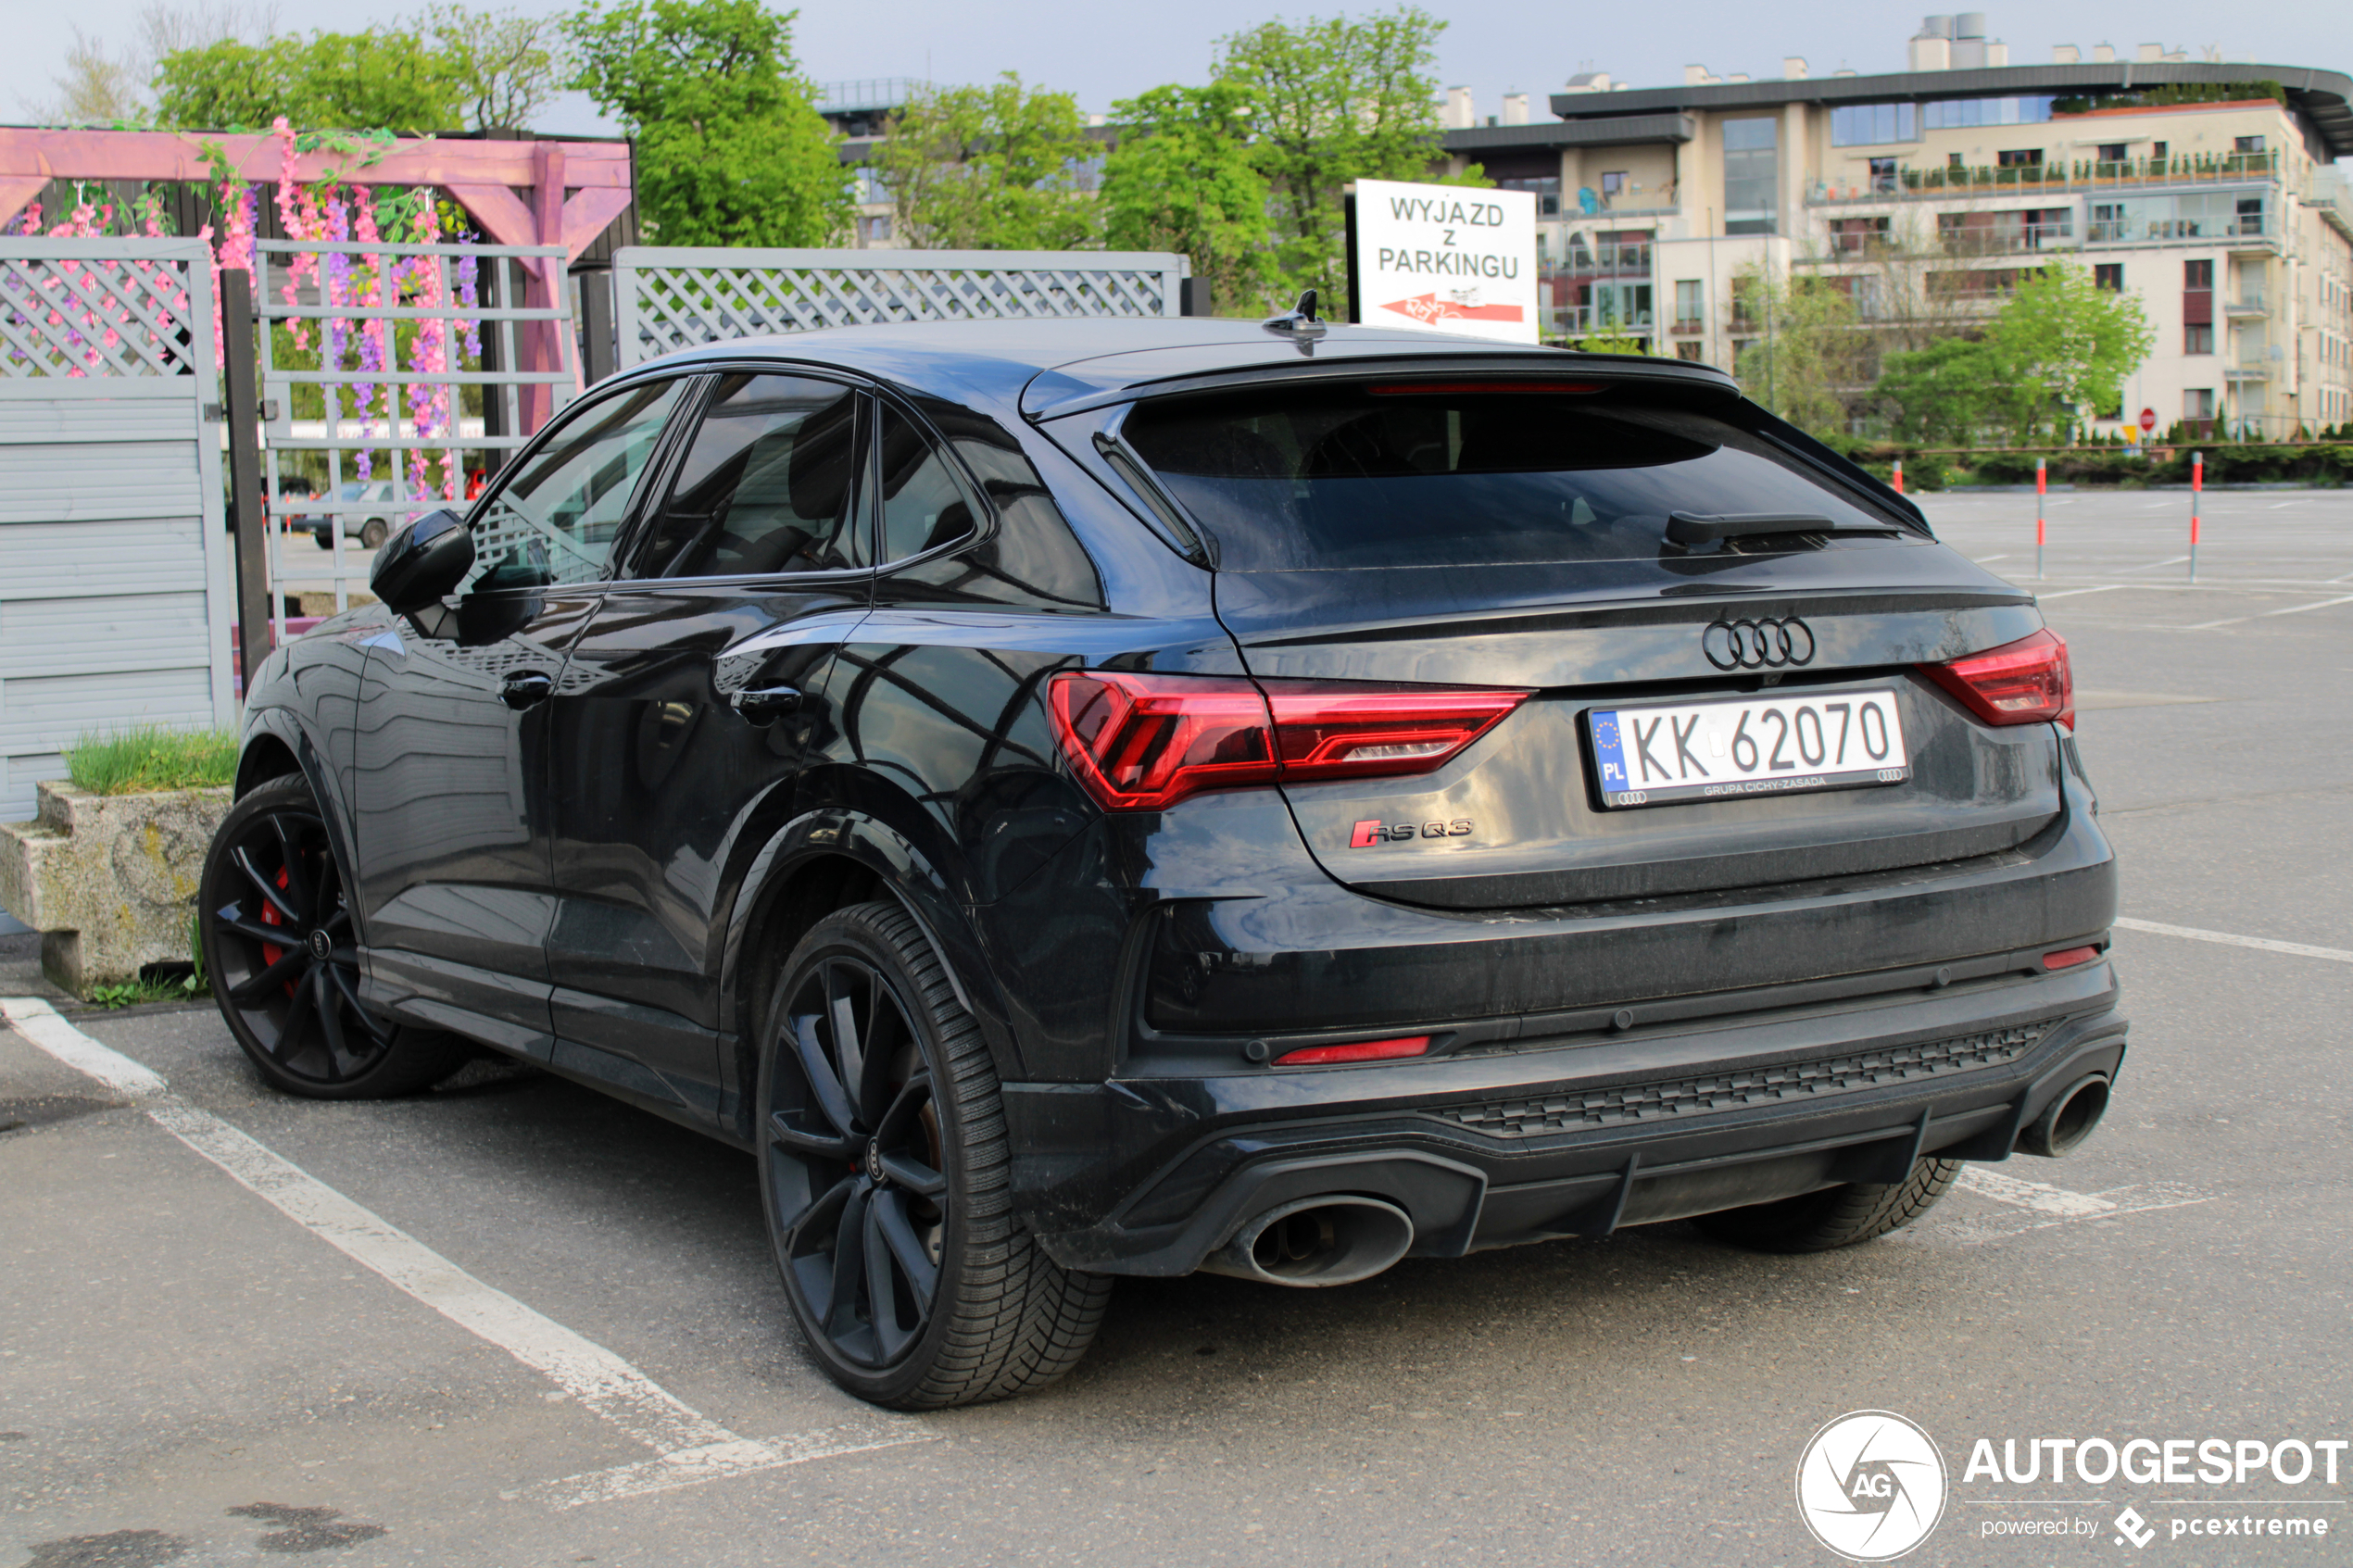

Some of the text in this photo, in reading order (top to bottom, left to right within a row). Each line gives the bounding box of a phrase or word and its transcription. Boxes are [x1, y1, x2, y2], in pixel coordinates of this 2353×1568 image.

[1390, 196, 1504, 228] WYJAZD
[1378, 248, 1518, 280] PARKINGU
[1632, 700, 1890, 783] KK 62070
[1603, 762, 1625, 782] PL
[1704, 777, 1827, 796] GRUPA CICHY-ZASADA
[1366, 818, 1475, 843] RS Q3
[842, 926, 889, 962] BRIDGESTONE
